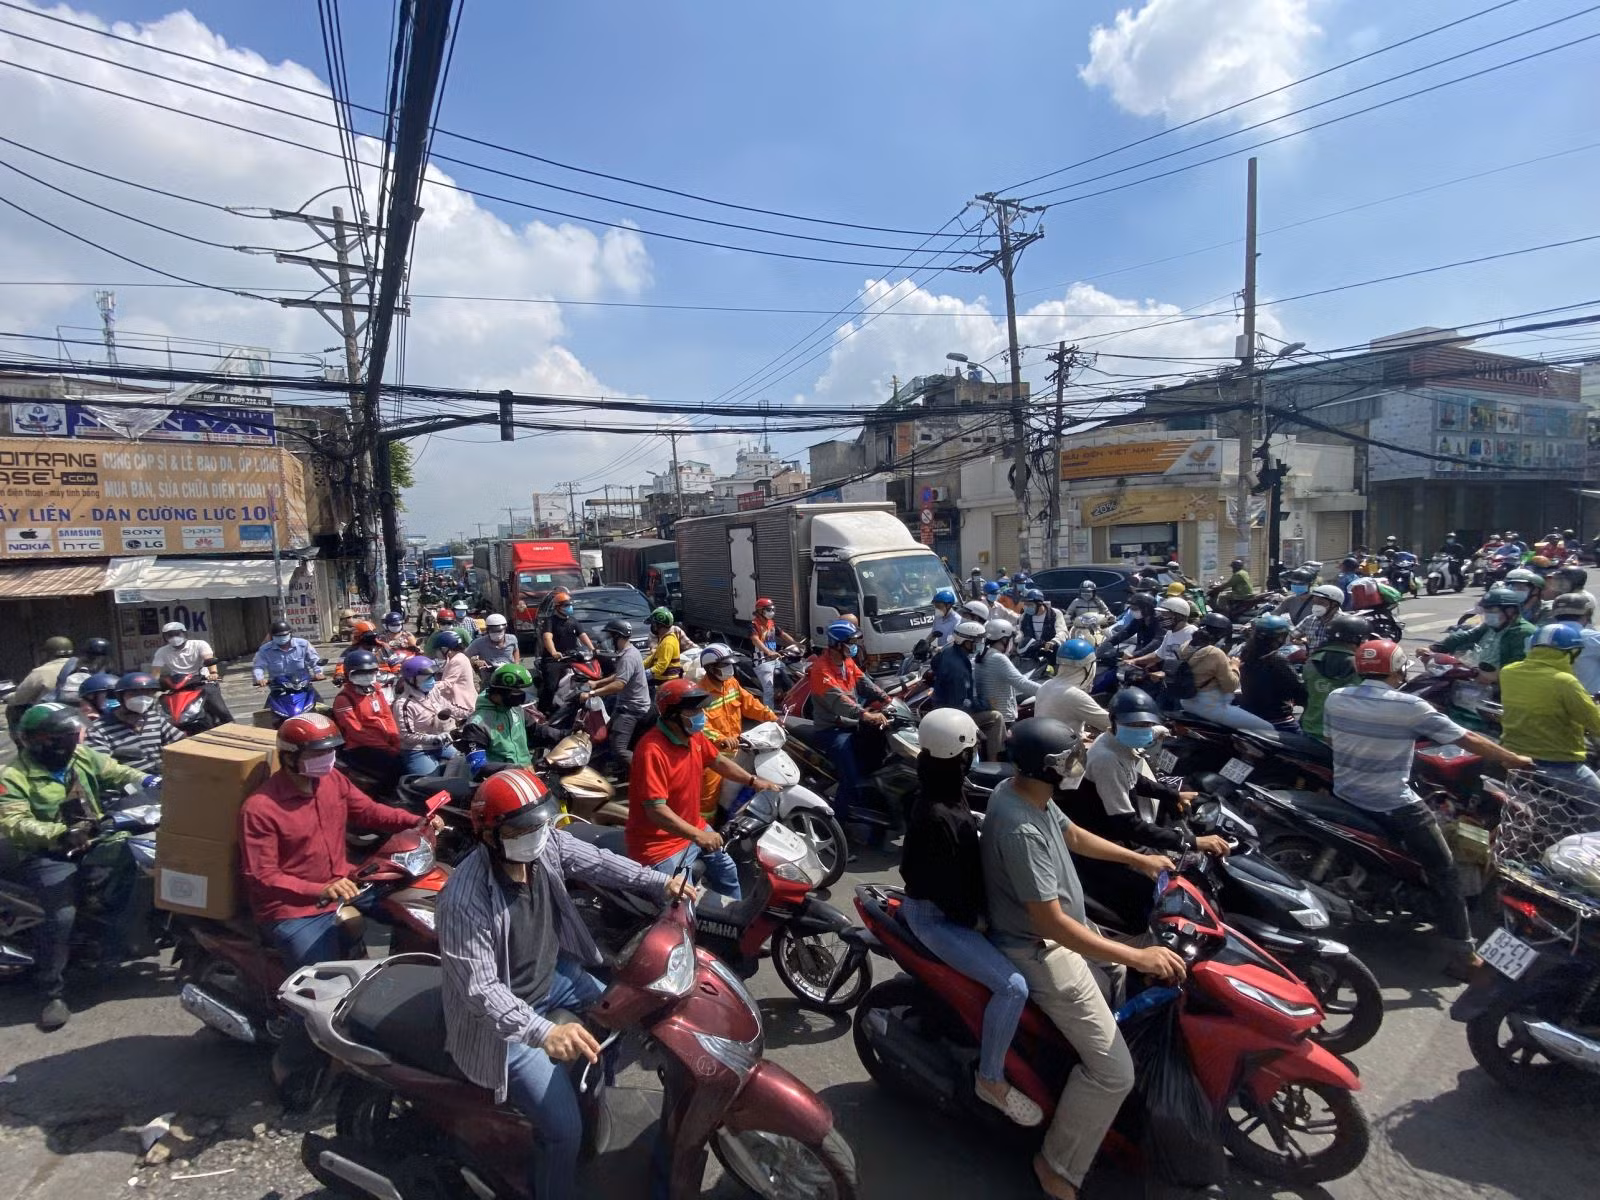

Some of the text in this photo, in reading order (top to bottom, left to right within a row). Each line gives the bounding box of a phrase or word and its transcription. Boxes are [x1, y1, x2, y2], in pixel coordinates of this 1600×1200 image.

[170, 455, 179, 471] &
[197, 455, 217, 472] BAO
[104, 480, 128, 499] MUA
[29, 502, 71, 522] LIỀN
[92, 504, 131, 522] DÁN
[137, 504, 198, 522] CƯỜNG
[58, 529, 102, 537] SAMSUNG
[121, 528, 162, 536] SONY
[8, 543, 51, 551] NOKIA
[158, 605, 208, 632] 10K
[696, 919, 739, 940] YAMAHA
